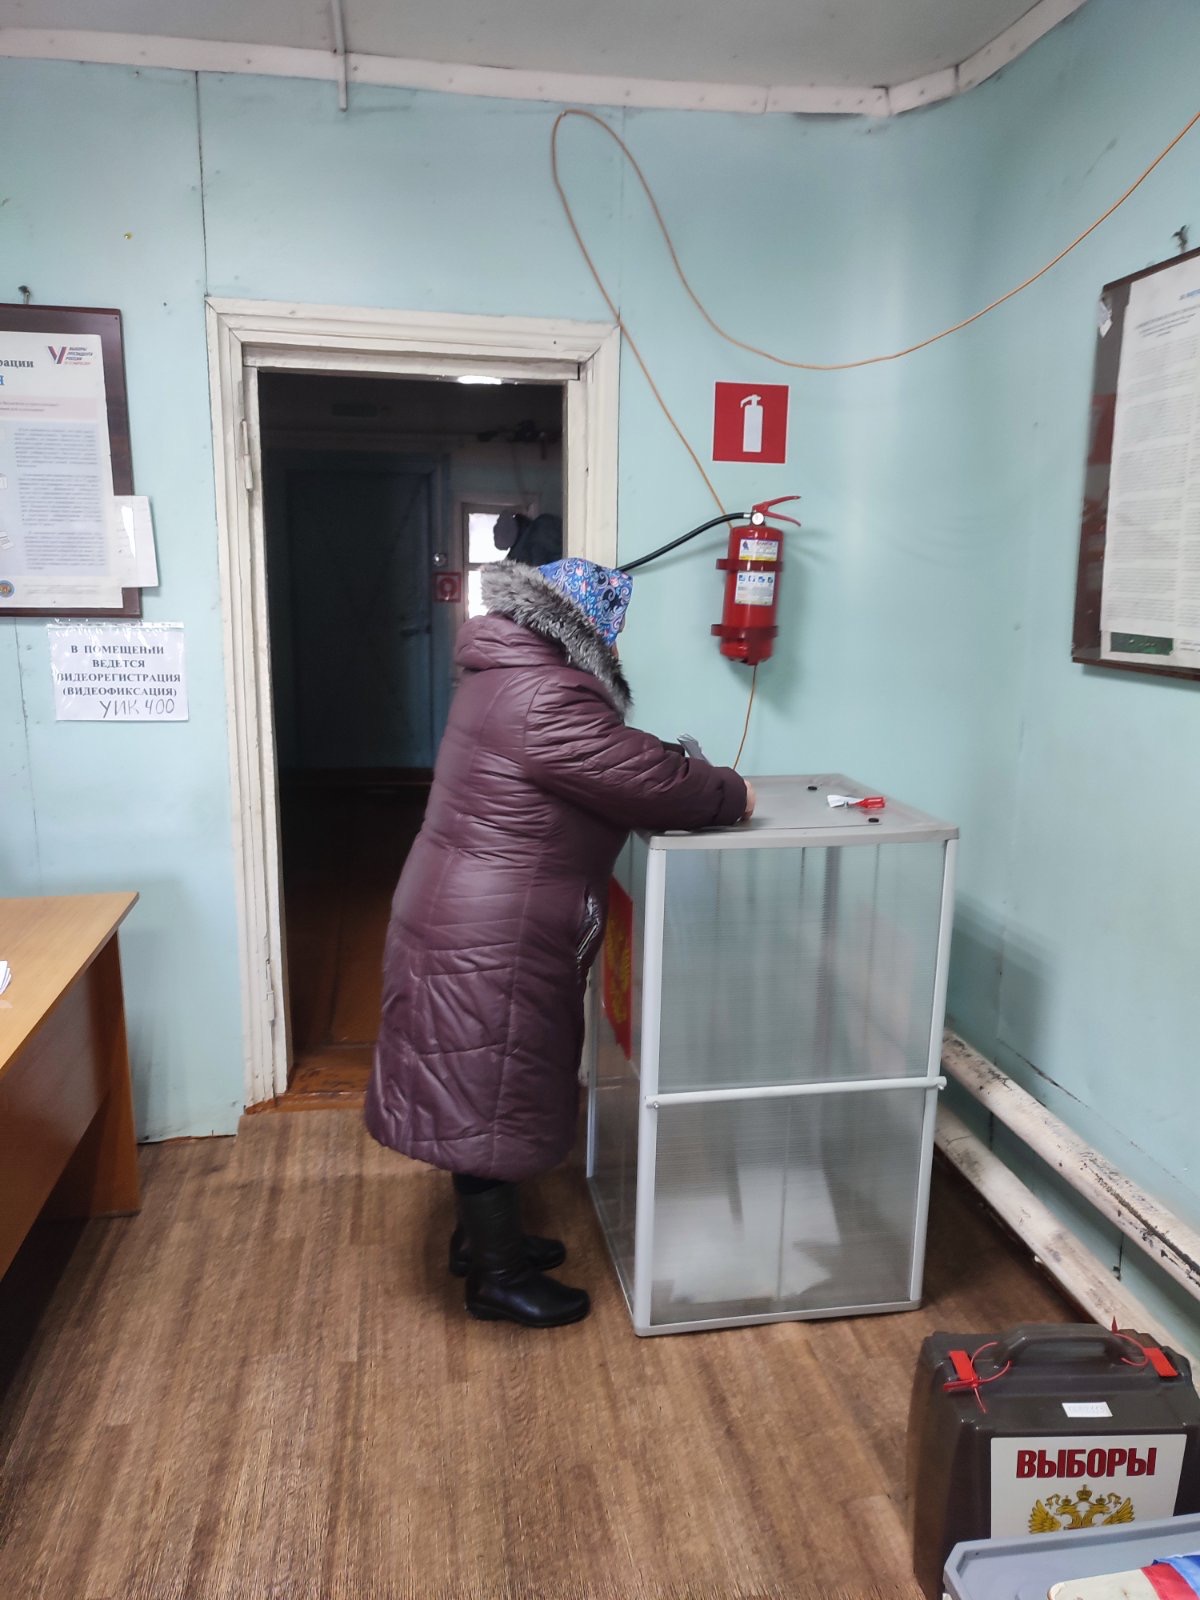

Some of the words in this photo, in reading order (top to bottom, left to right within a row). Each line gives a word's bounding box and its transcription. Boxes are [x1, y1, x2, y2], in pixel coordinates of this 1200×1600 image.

[71, 645, 79, 654] В
[84, 645, 164, 655] ПОМЕЩЕНИИ
[92, 659, 145, 668] ВЕДЕТСЯ
[62, 687, 177, 697] (ВИДЕОФИКСАЦИЯ)
[145, 698, 175, 715] 400
[1016, 1447, 1157, 1479] ВЫБОРЫ
